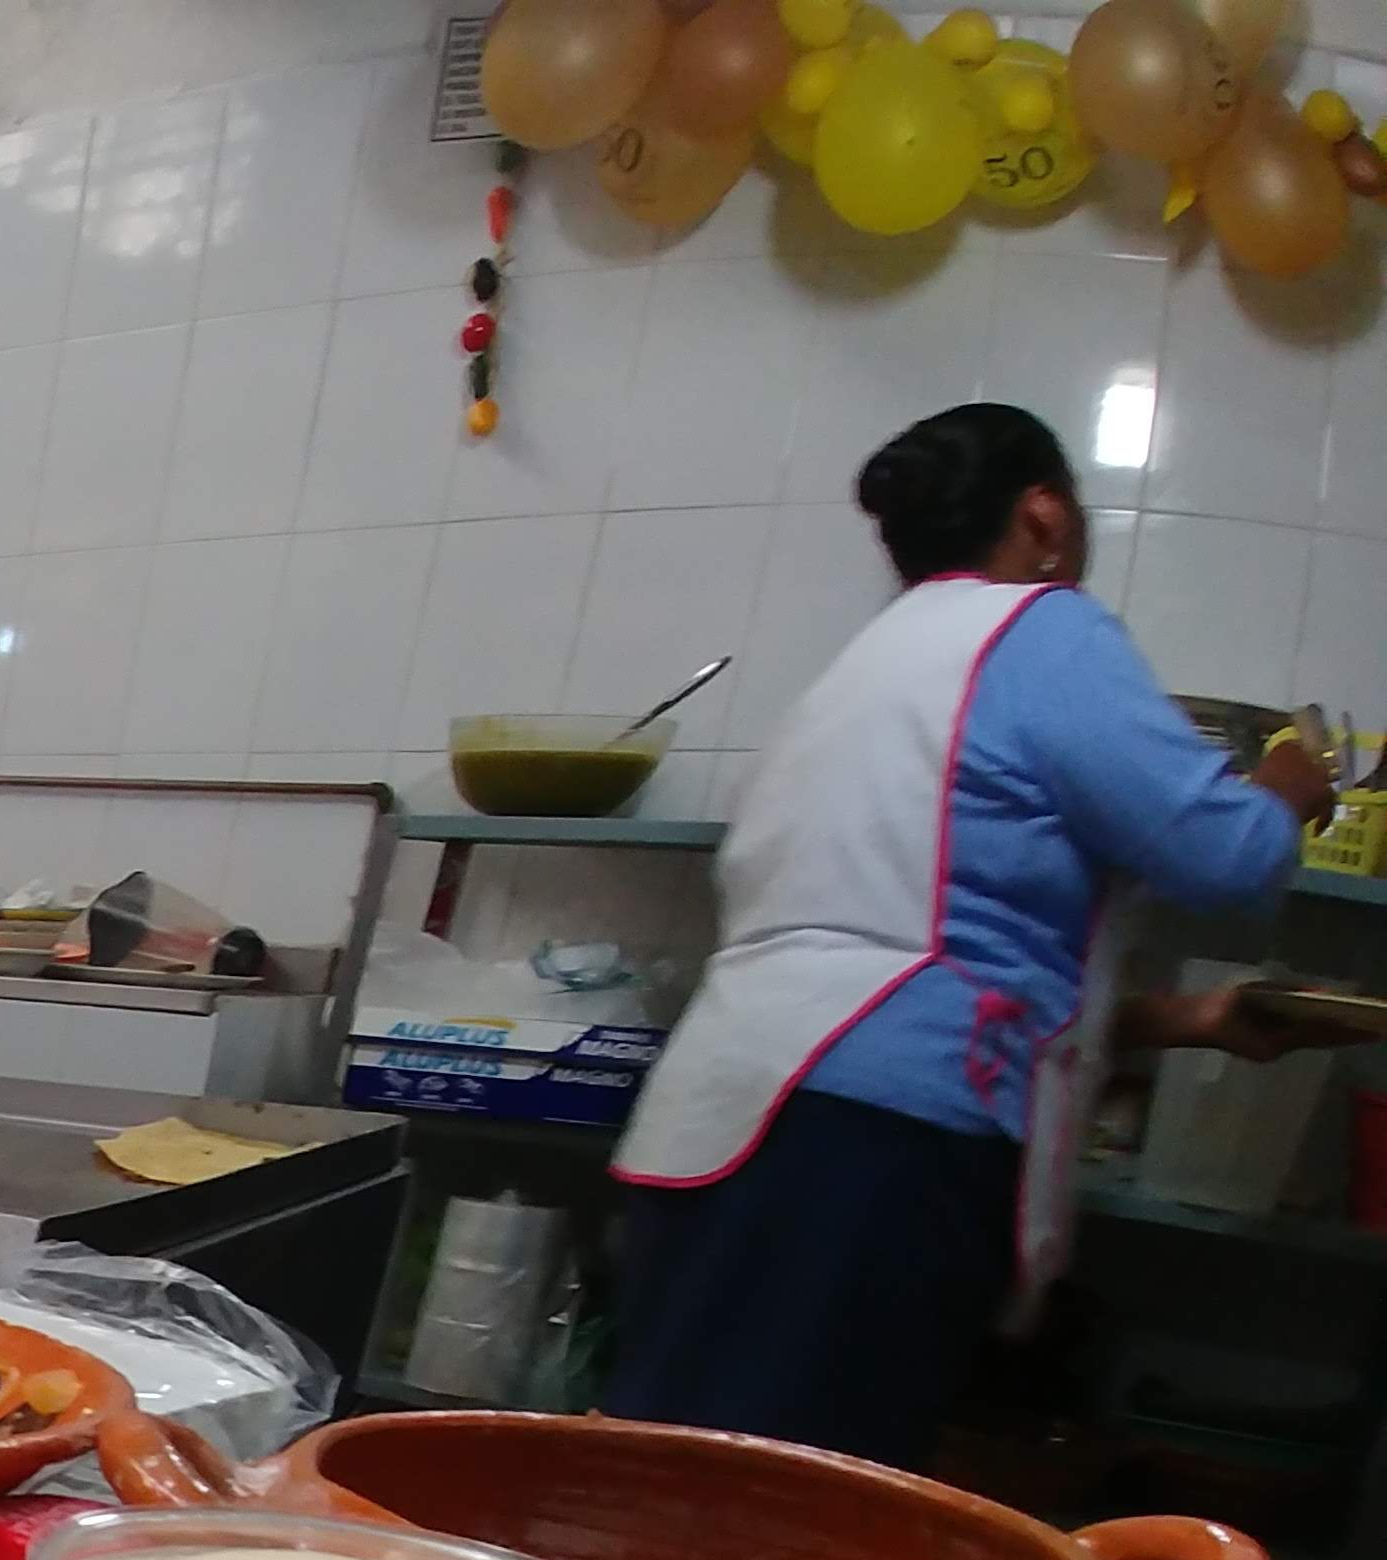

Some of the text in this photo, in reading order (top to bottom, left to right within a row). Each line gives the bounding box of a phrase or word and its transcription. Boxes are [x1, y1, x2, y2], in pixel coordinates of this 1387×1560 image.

[983, 145, 1055, 190] 50
[387, 1021, 509, 1047] ALUPLUS
[380, 1049, 502, 1077] ALUPLUS
